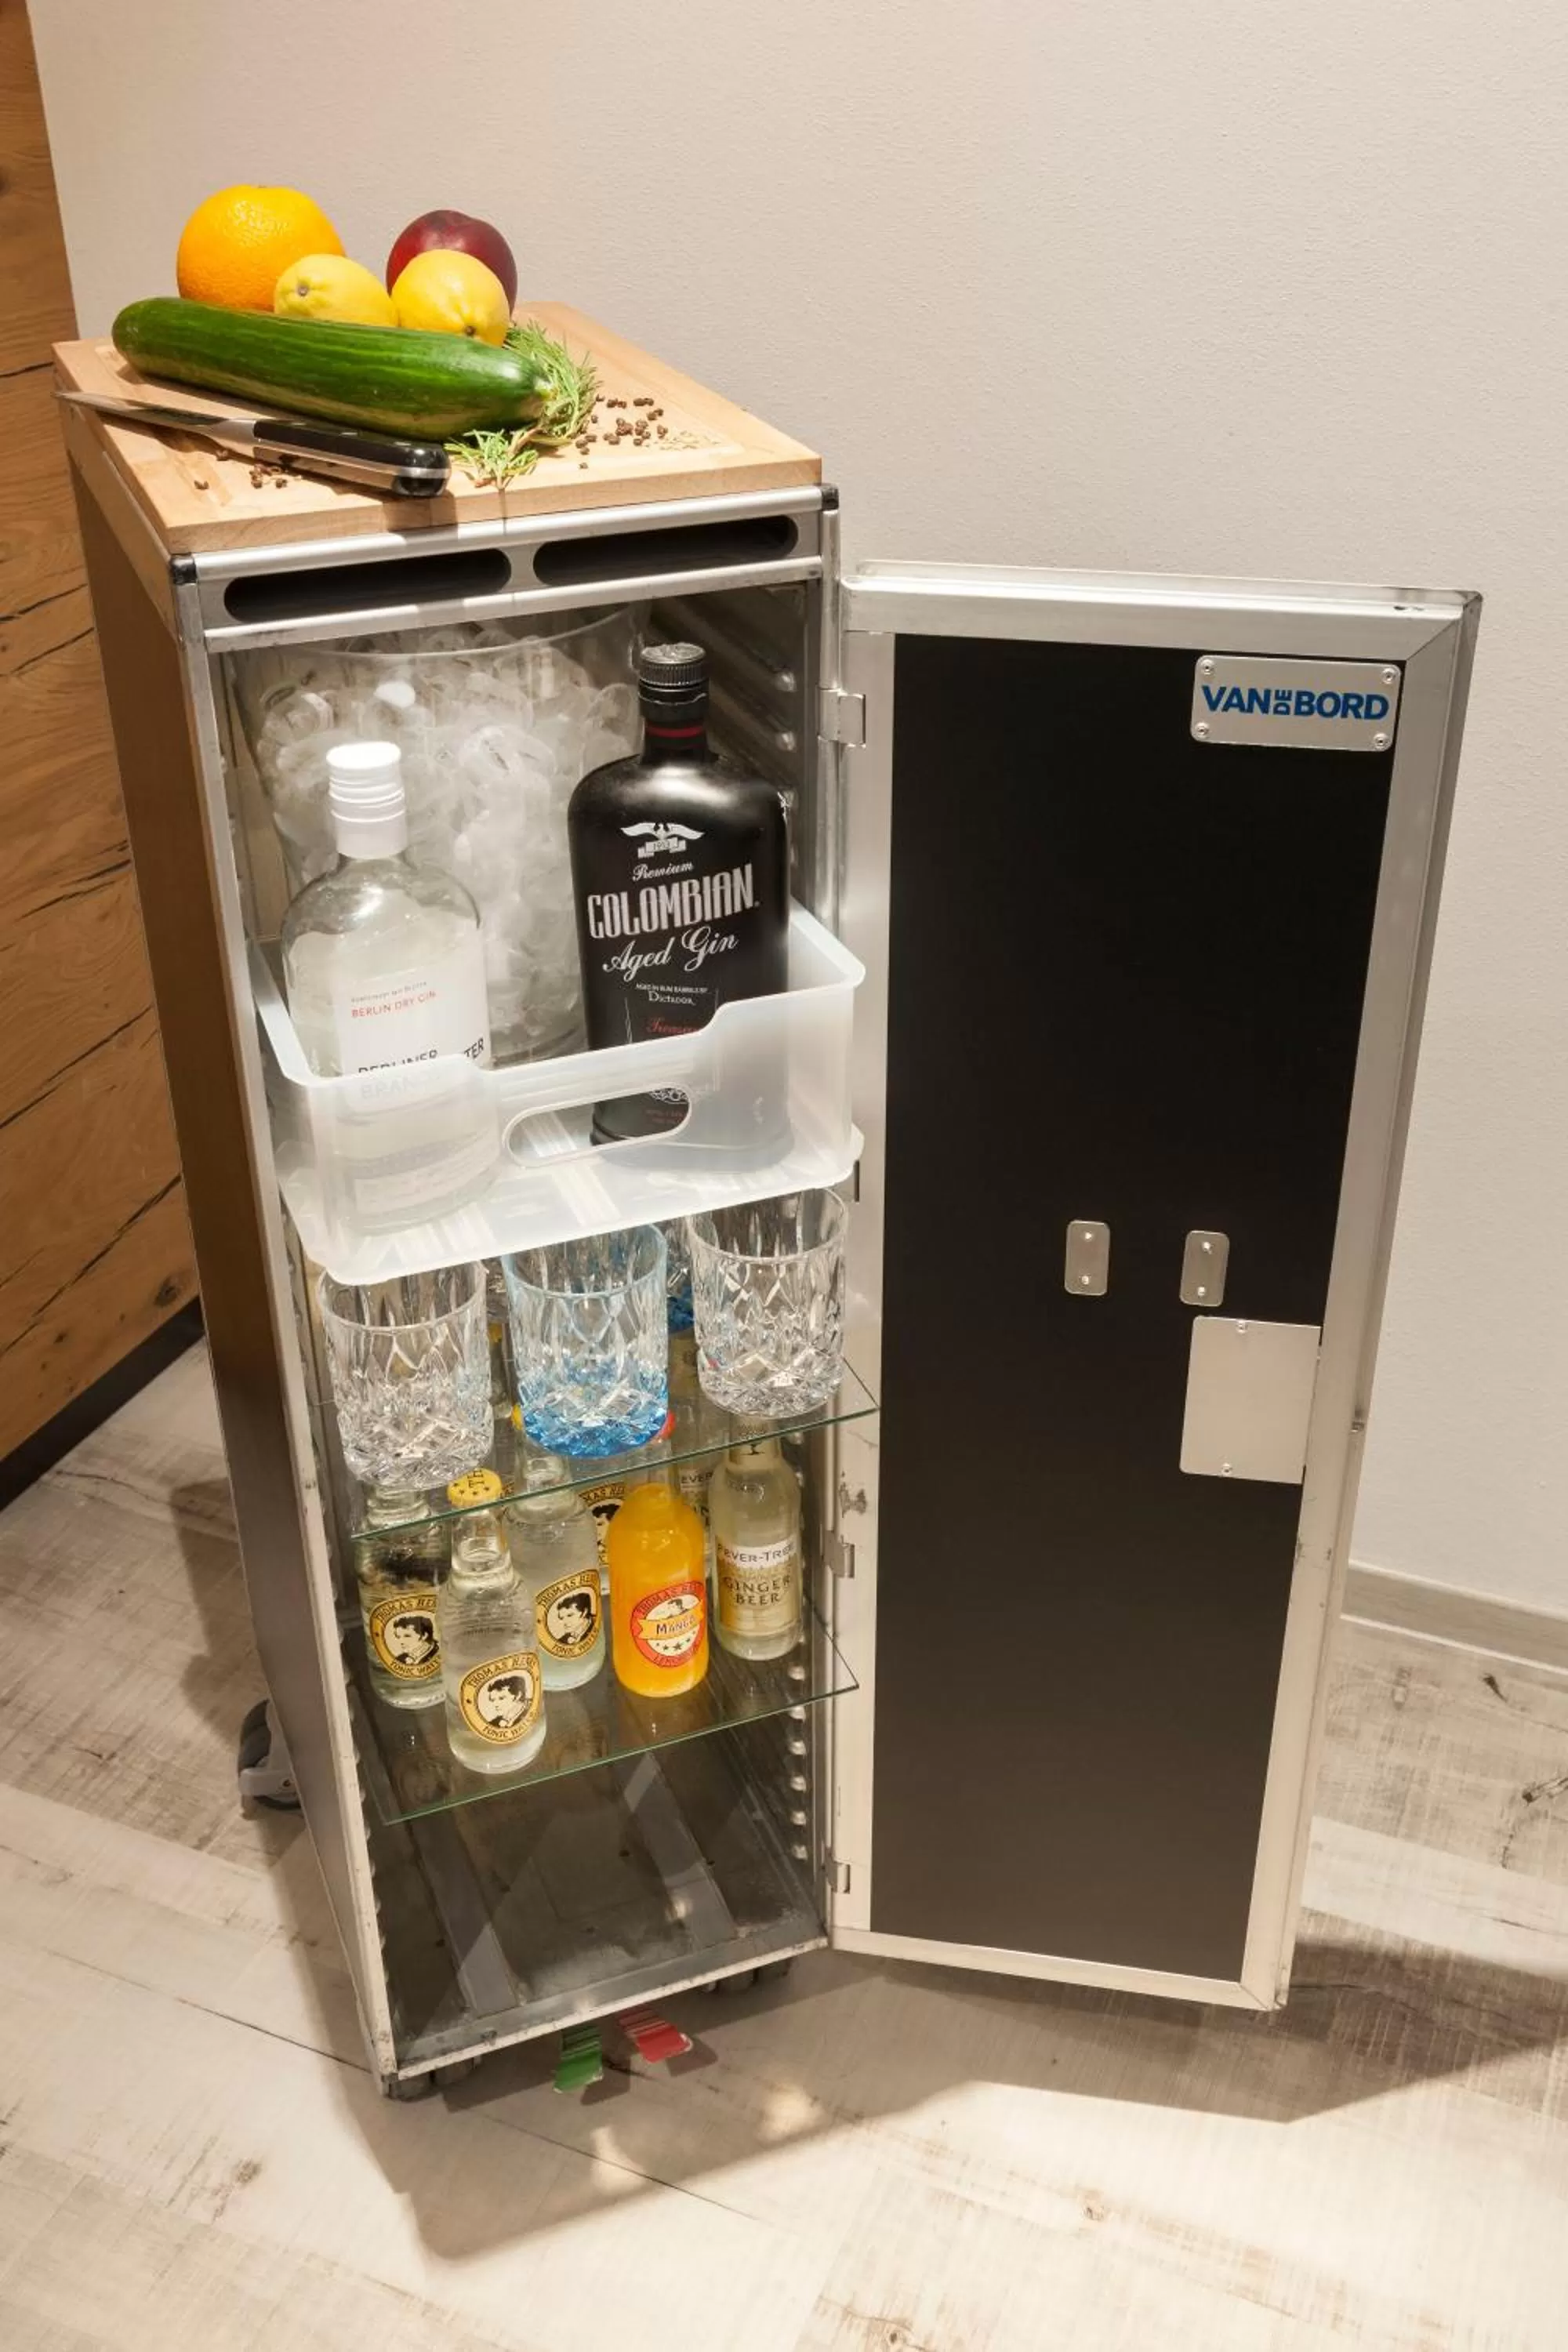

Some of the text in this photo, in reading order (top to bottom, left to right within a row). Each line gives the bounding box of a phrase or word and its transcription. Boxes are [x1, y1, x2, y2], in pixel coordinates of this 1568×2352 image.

[1202, 685, 1389, 720] VAN DE BORD
[632, 862, 694, 882] Premium
[587, 863, 754, 939] COLOMBIAN
[602, 926, 739, 982] Aged Gin
[351, 1004, 391, 1018] BERLIN
[394, 997, 415, 1011] DRY
[418, 990, 437, 1004] GIN
[537, 1578, 577, 1606] THOMAS
[722, 1574, 790, 1593] GINGER
[376, 1599, 414, 1622] THOMAS
[735, 1592, 779, 1606] BEER
[390, 1661, 413, 1675] TONIC
[467, 1660, 508, 1687] THOMAS
[482, 1725, 508, 1738] TONIC
